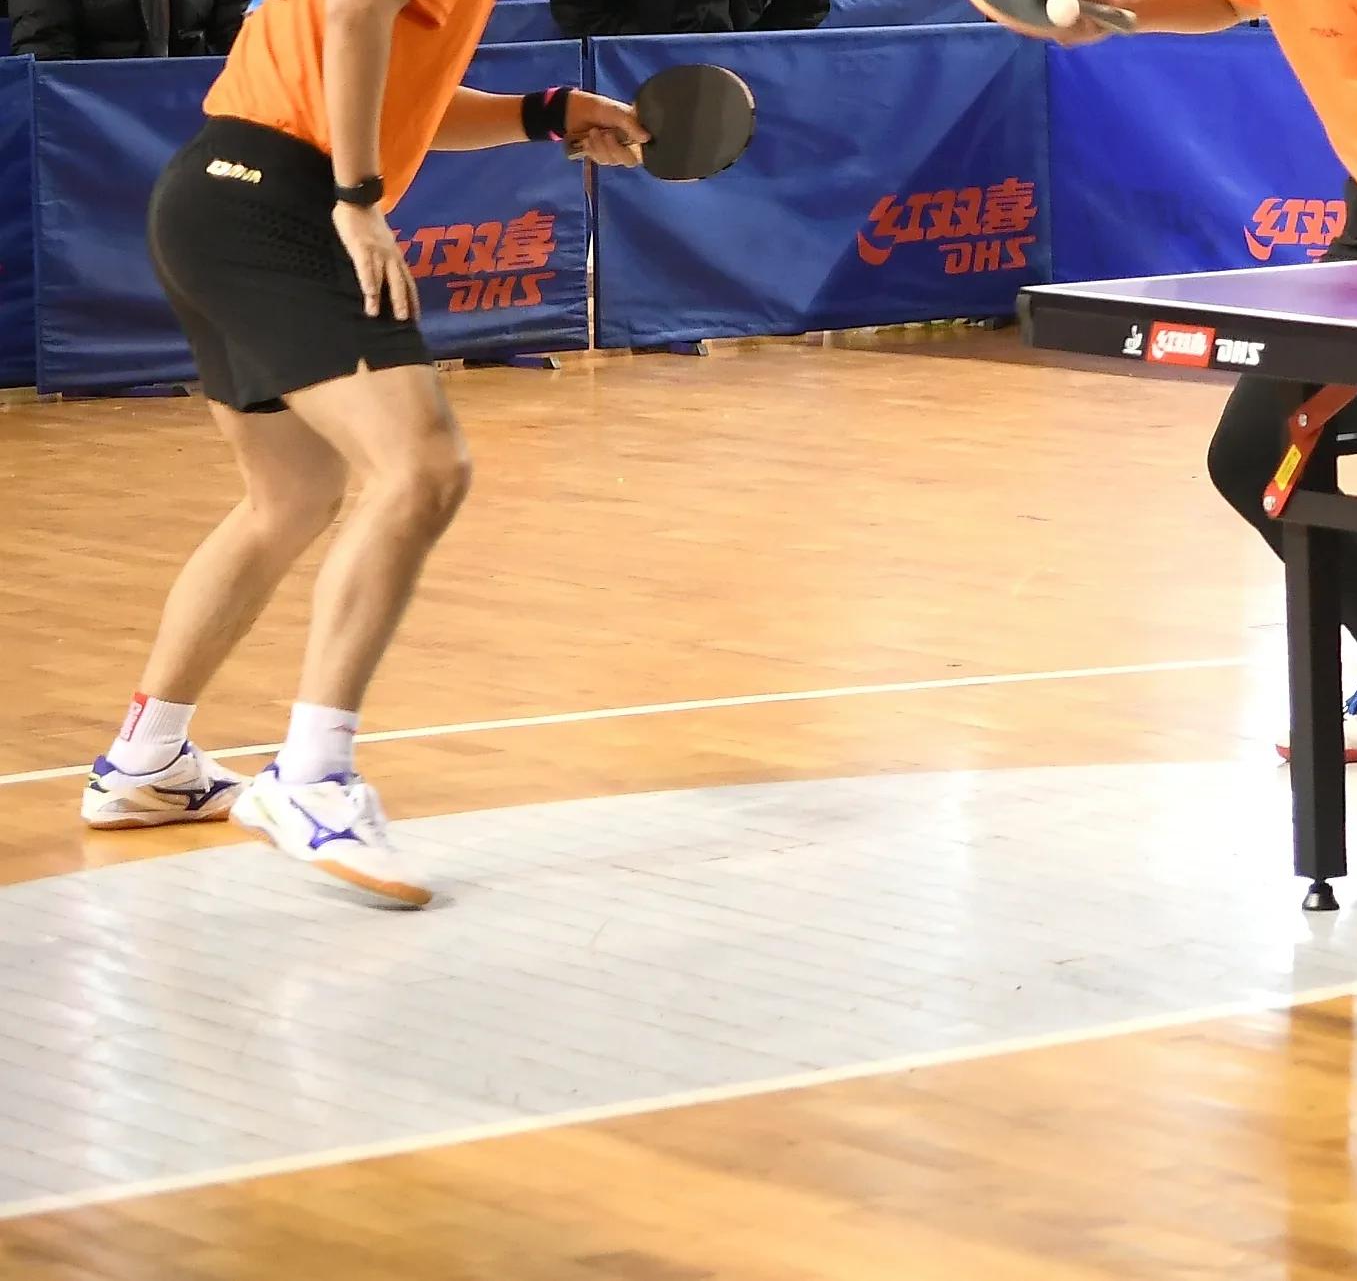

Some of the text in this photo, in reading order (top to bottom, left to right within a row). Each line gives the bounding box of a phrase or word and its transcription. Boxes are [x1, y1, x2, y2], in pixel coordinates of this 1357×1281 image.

[857, 176, 1038, 266] 红双喜
[1243, 197, 1347, 261] 红双
[938, 235, 1037, 275] DHS
[446, 271, 556, 313] DHS
[1215, 337, 1266, 366] DHS
